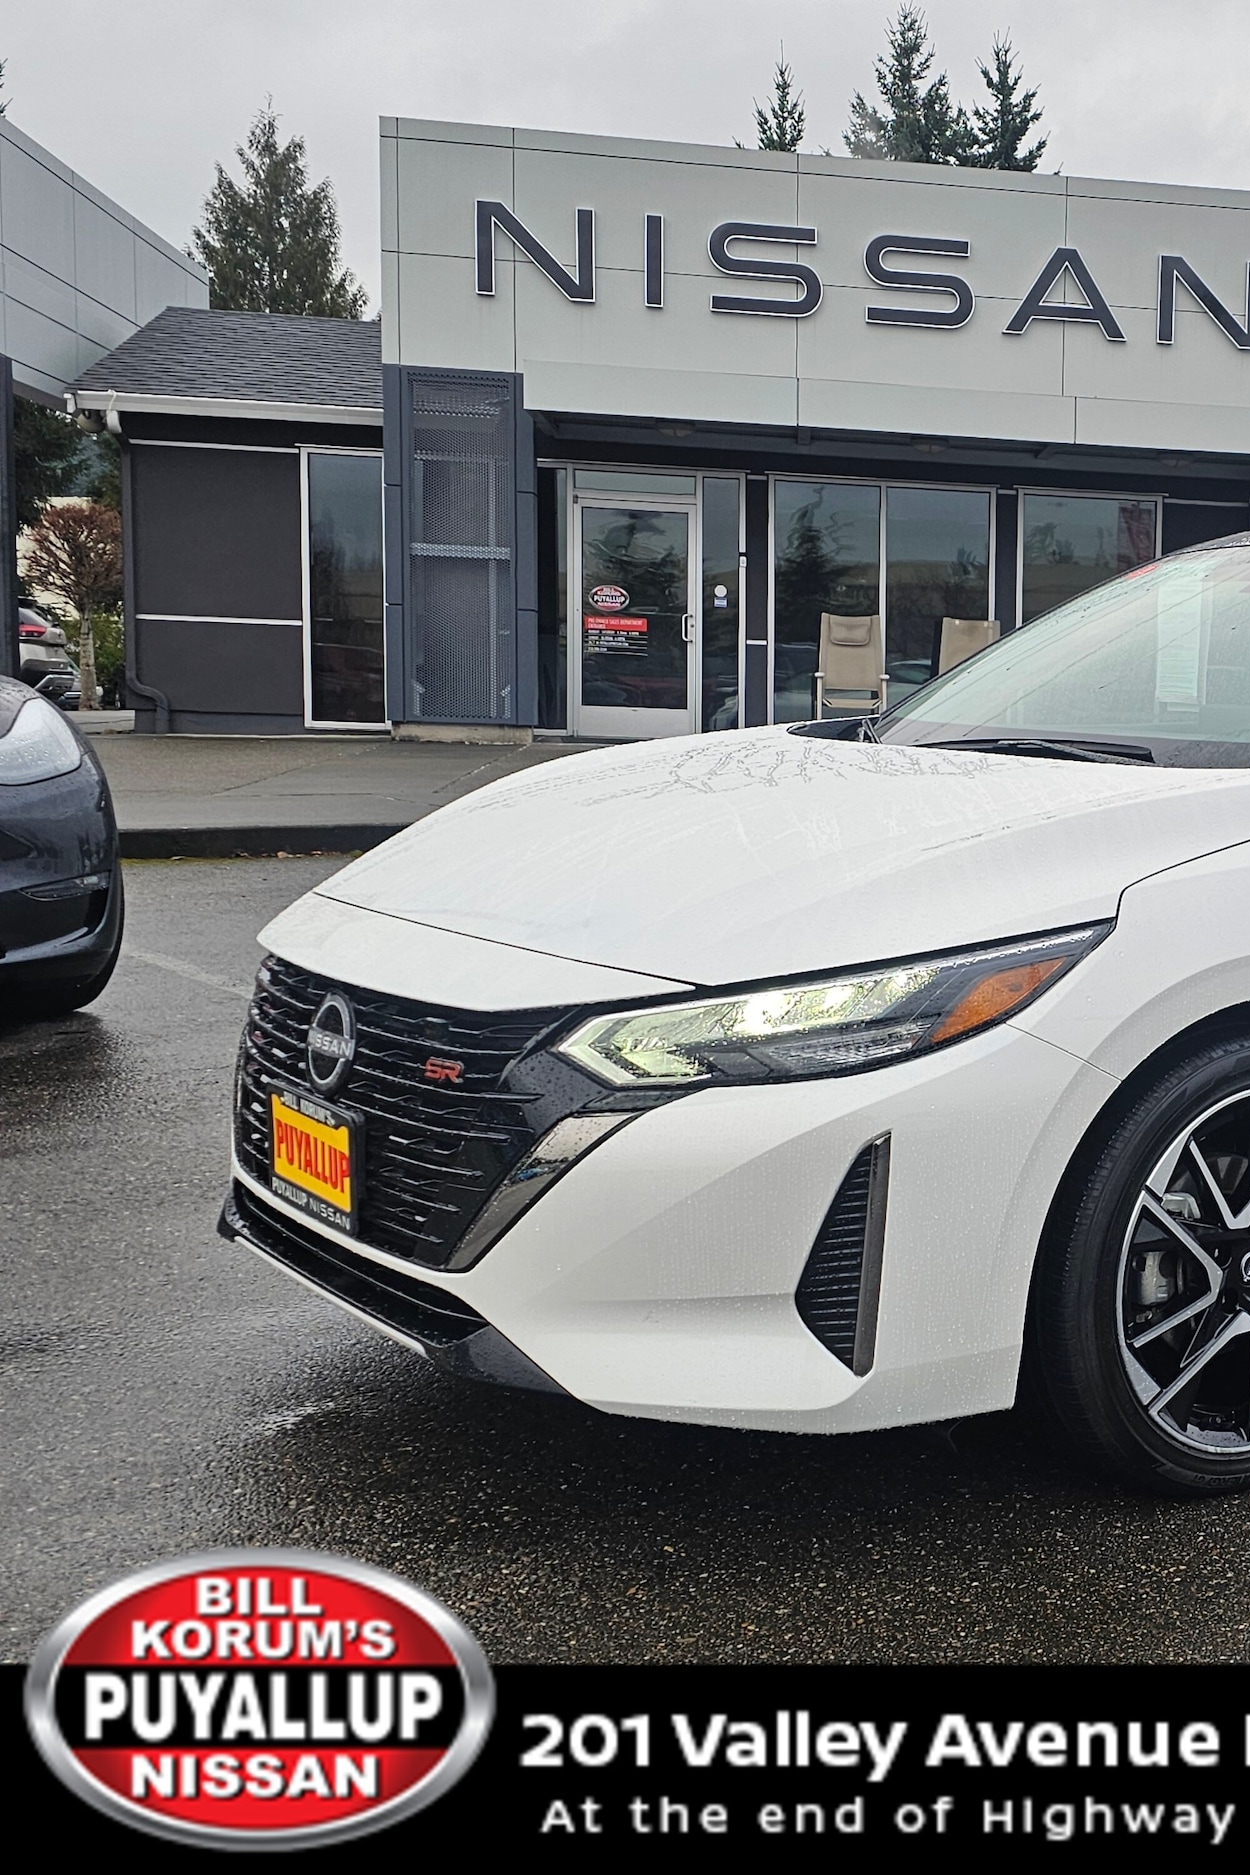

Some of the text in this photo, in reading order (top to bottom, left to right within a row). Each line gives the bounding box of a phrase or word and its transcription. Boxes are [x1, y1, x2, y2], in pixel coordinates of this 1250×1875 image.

[593, 595, 625, 603] PUYALLUP
[425, 1057, 464, 1083] SR
[275, 1117, 350, 1194] PUYALLUP
[271, 1176, 351, 1231] PUYALLUP NISSAN
